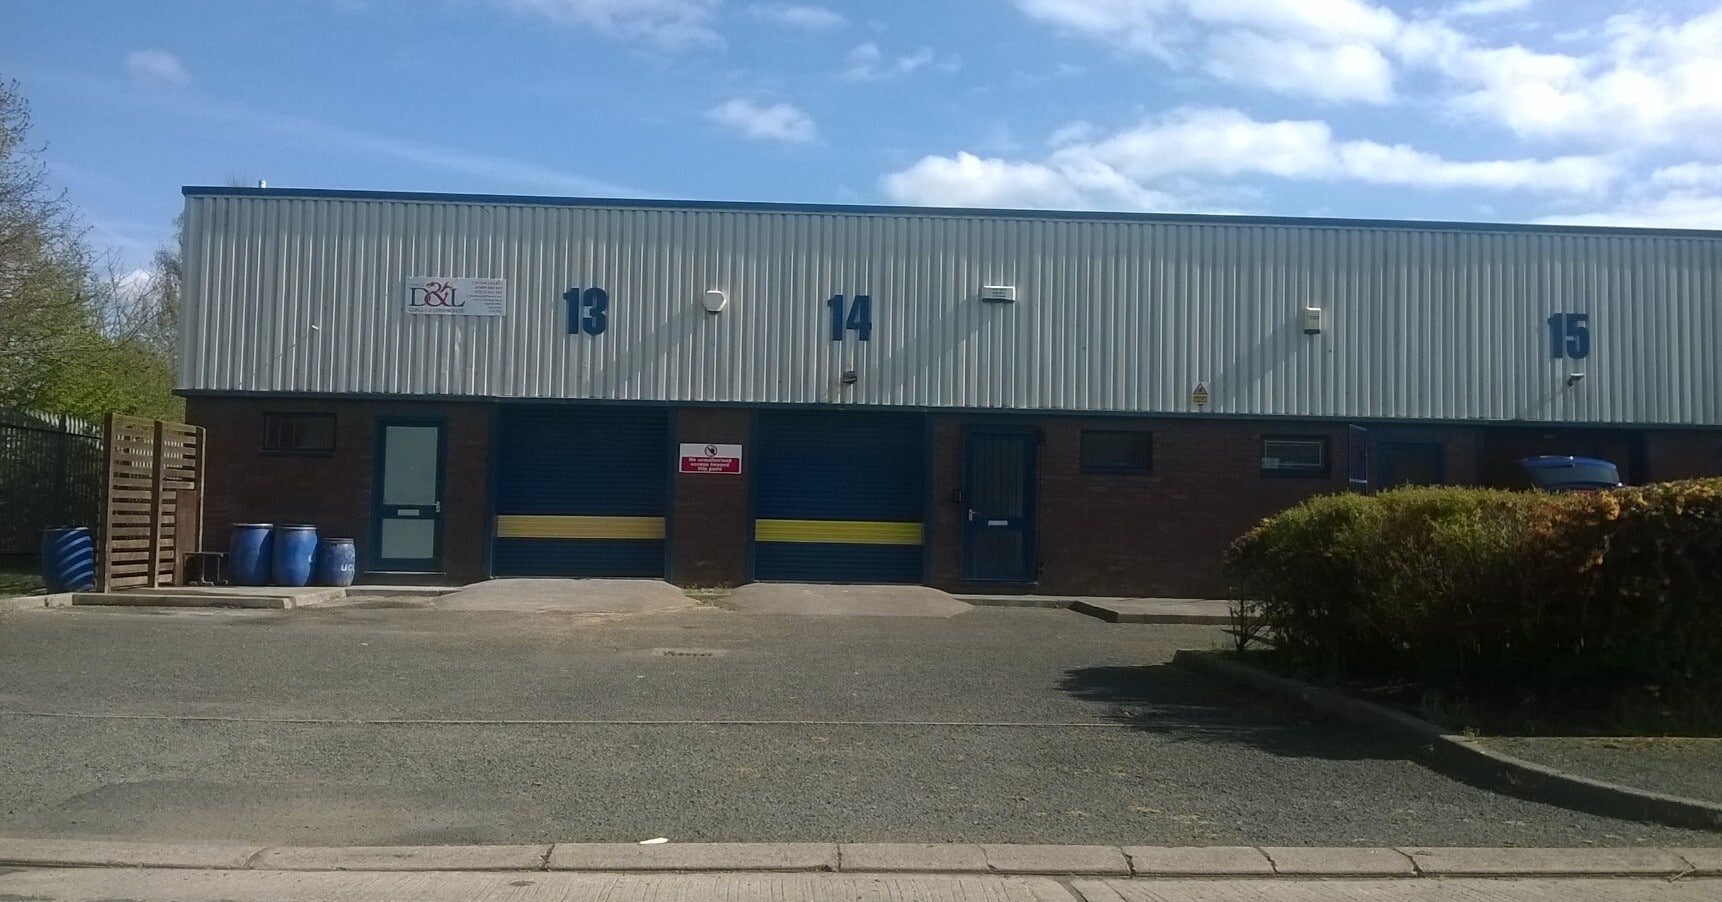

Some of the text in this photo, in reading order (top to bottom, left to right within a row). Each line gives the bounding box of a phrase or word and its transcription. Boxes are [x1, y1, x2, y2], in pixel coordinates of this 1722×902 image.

[409, 281, 466, 307] D&L
[563, 287, 608, 336] 13
[827, 294, 872, 341] 14
[1548, 313, 1590, 360] 15
